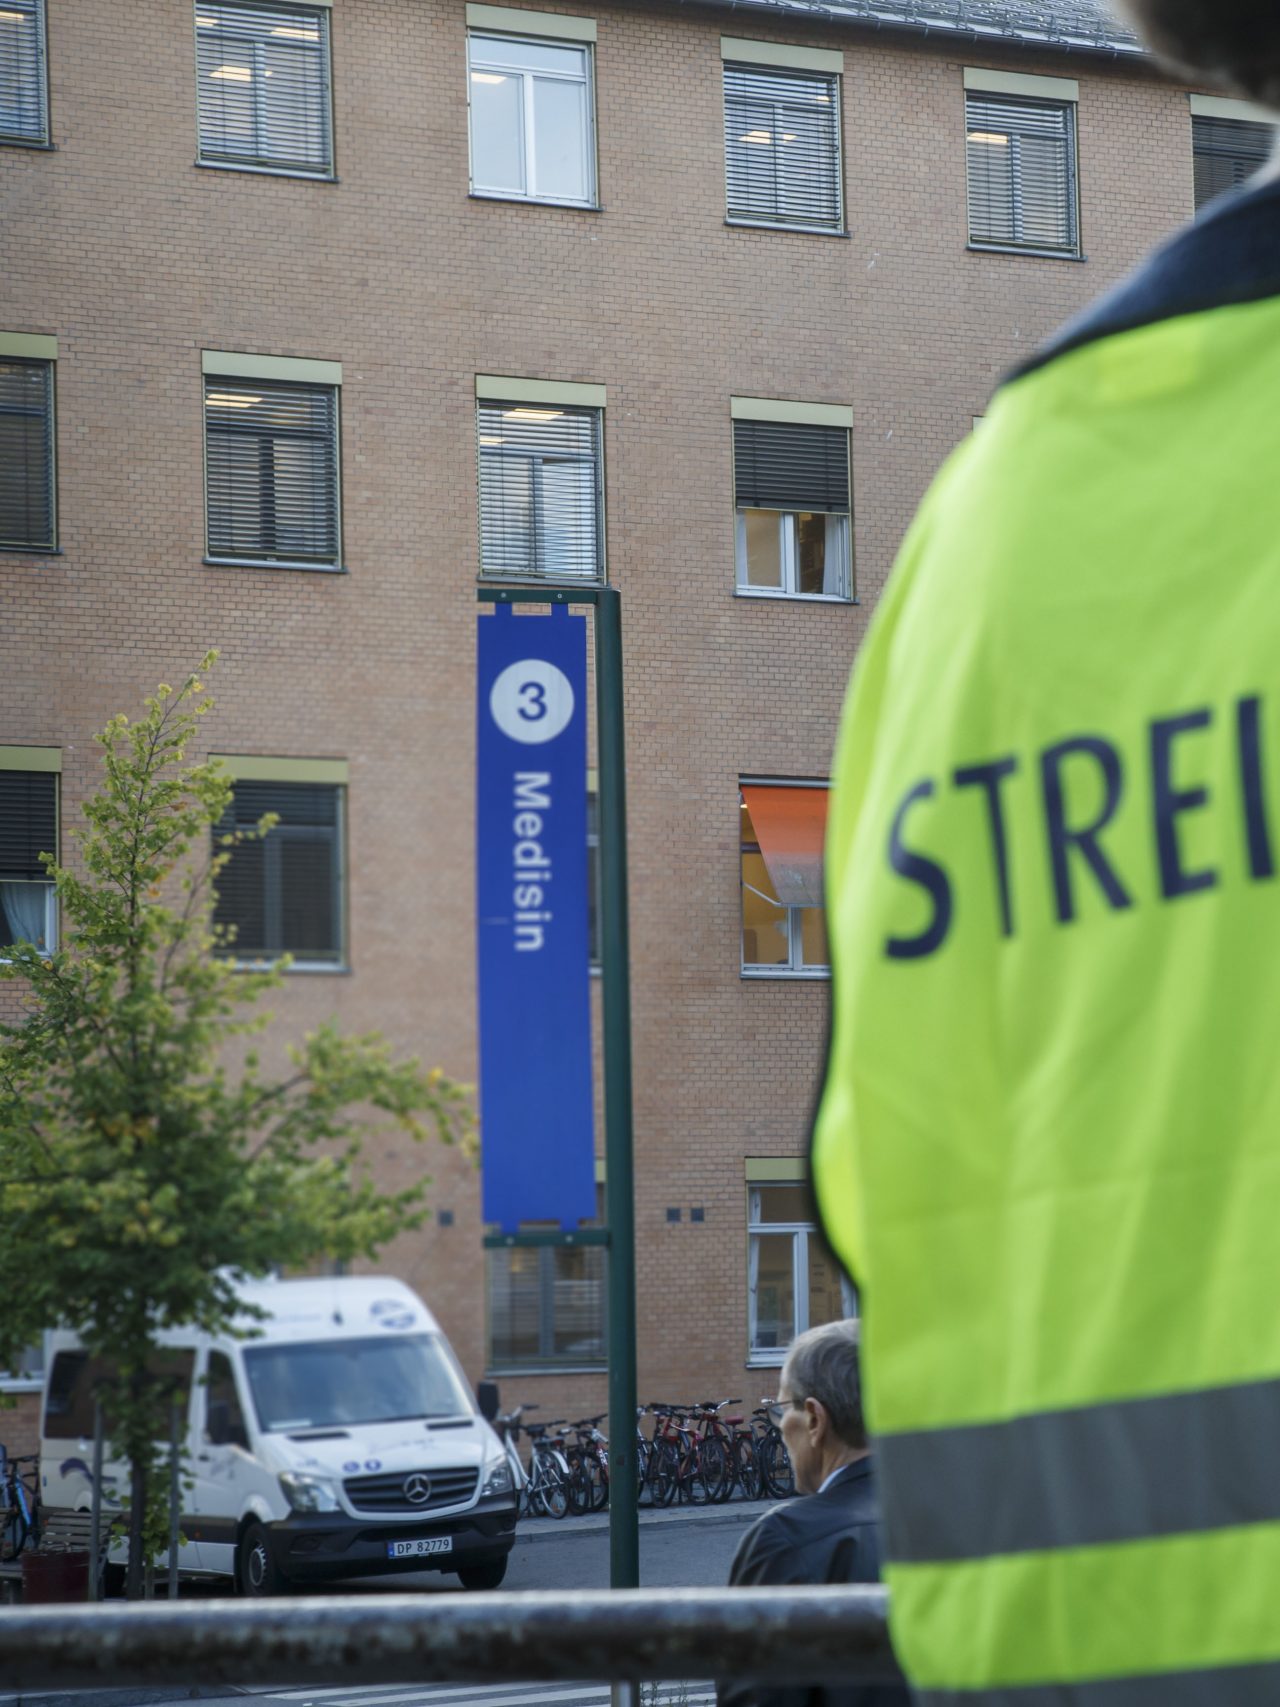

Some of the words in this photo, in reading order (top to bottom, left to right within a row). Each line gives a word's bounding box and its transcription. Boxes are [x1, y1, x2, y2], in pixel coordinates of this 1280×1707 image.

[517, 680, 548, 722] 3
[513, 771, 552, 951] Medisin
[397, 1542, 412, 1554] DP
[416, 1539, 450, 1553] 82779
